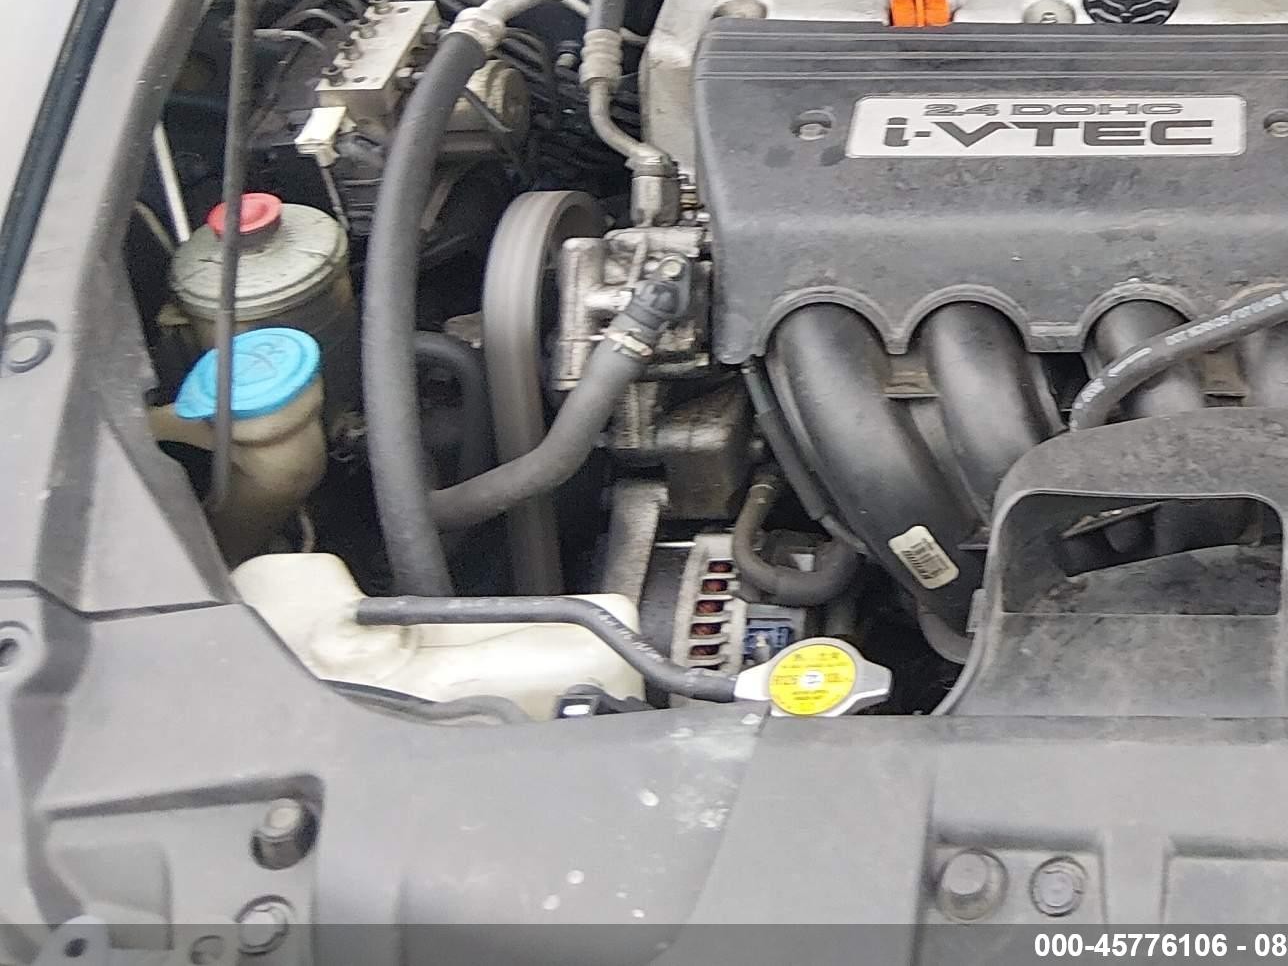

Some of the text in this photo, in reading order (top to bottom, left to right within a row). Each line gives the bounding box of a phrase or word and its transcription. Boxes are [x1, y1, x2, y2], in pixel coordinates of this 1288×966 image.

[924, 102, 1184, 117] 2.4 DOHC
[882, 116, 1214, 148] i-VTEC
